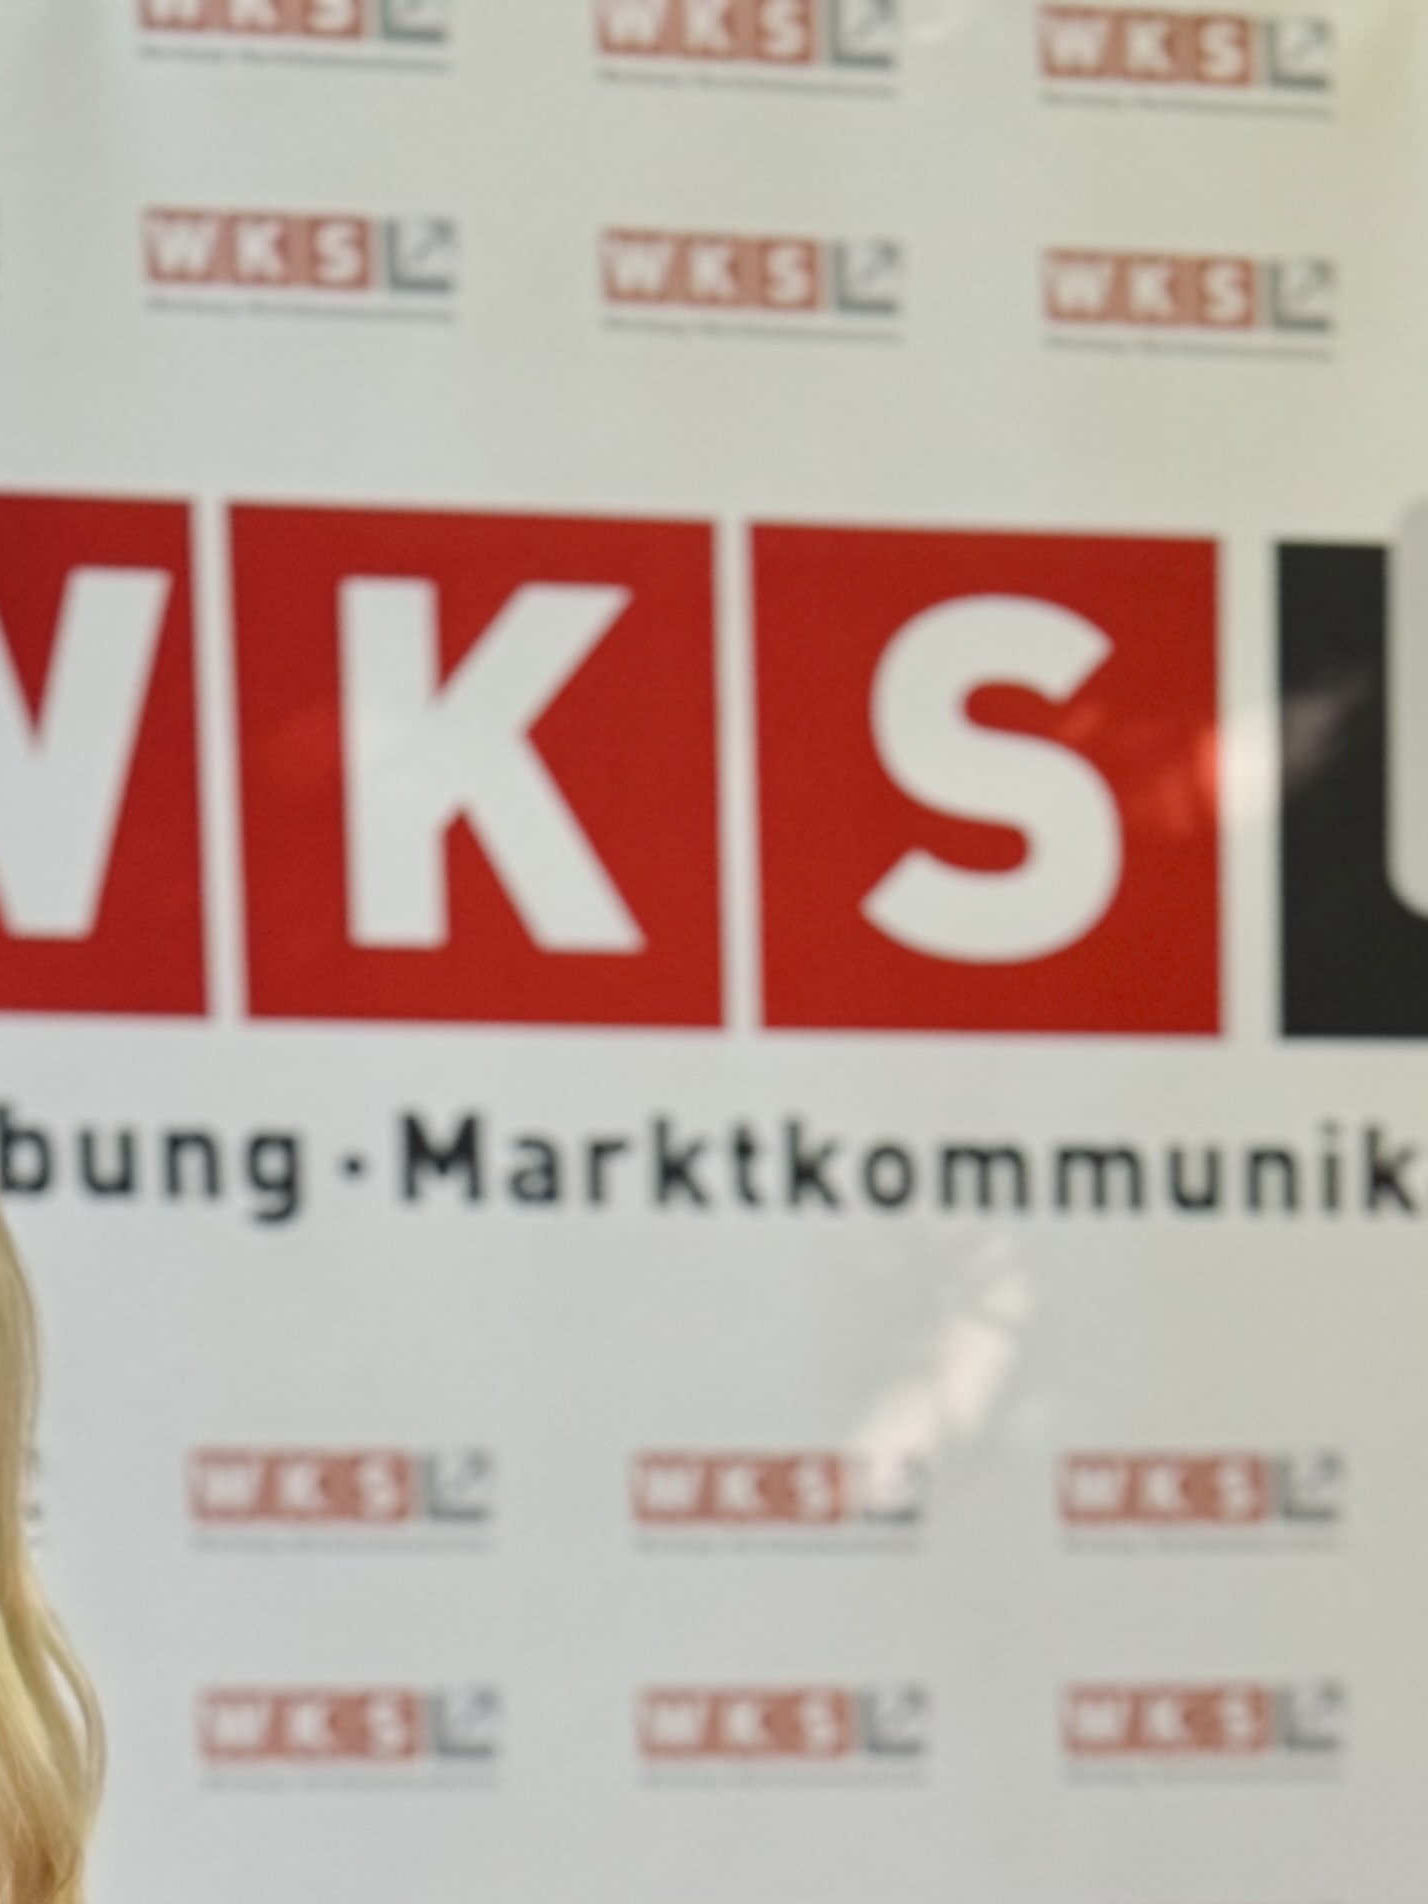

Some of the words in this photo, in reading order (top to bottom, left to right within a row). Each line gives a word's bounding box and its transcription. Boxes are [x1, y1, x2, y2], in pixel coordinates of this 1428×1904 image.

[1042, 11, 1245, 79] WKS
[148, 218, 364, 282] WKS
[604, 238, 812, 303] WKS
[1047, 258, 1248, 322] WKS
[196, 1459, 403, 1515] WKS
[637, 1463, 838, 1516] WKS
[1062, 1463, 1259, 1517] WKS
[205, 1699, 411, 1752] WKS
[643, 1696, 843, 1750] WKS
[1066, 1694, 1260, 1748] WKS
